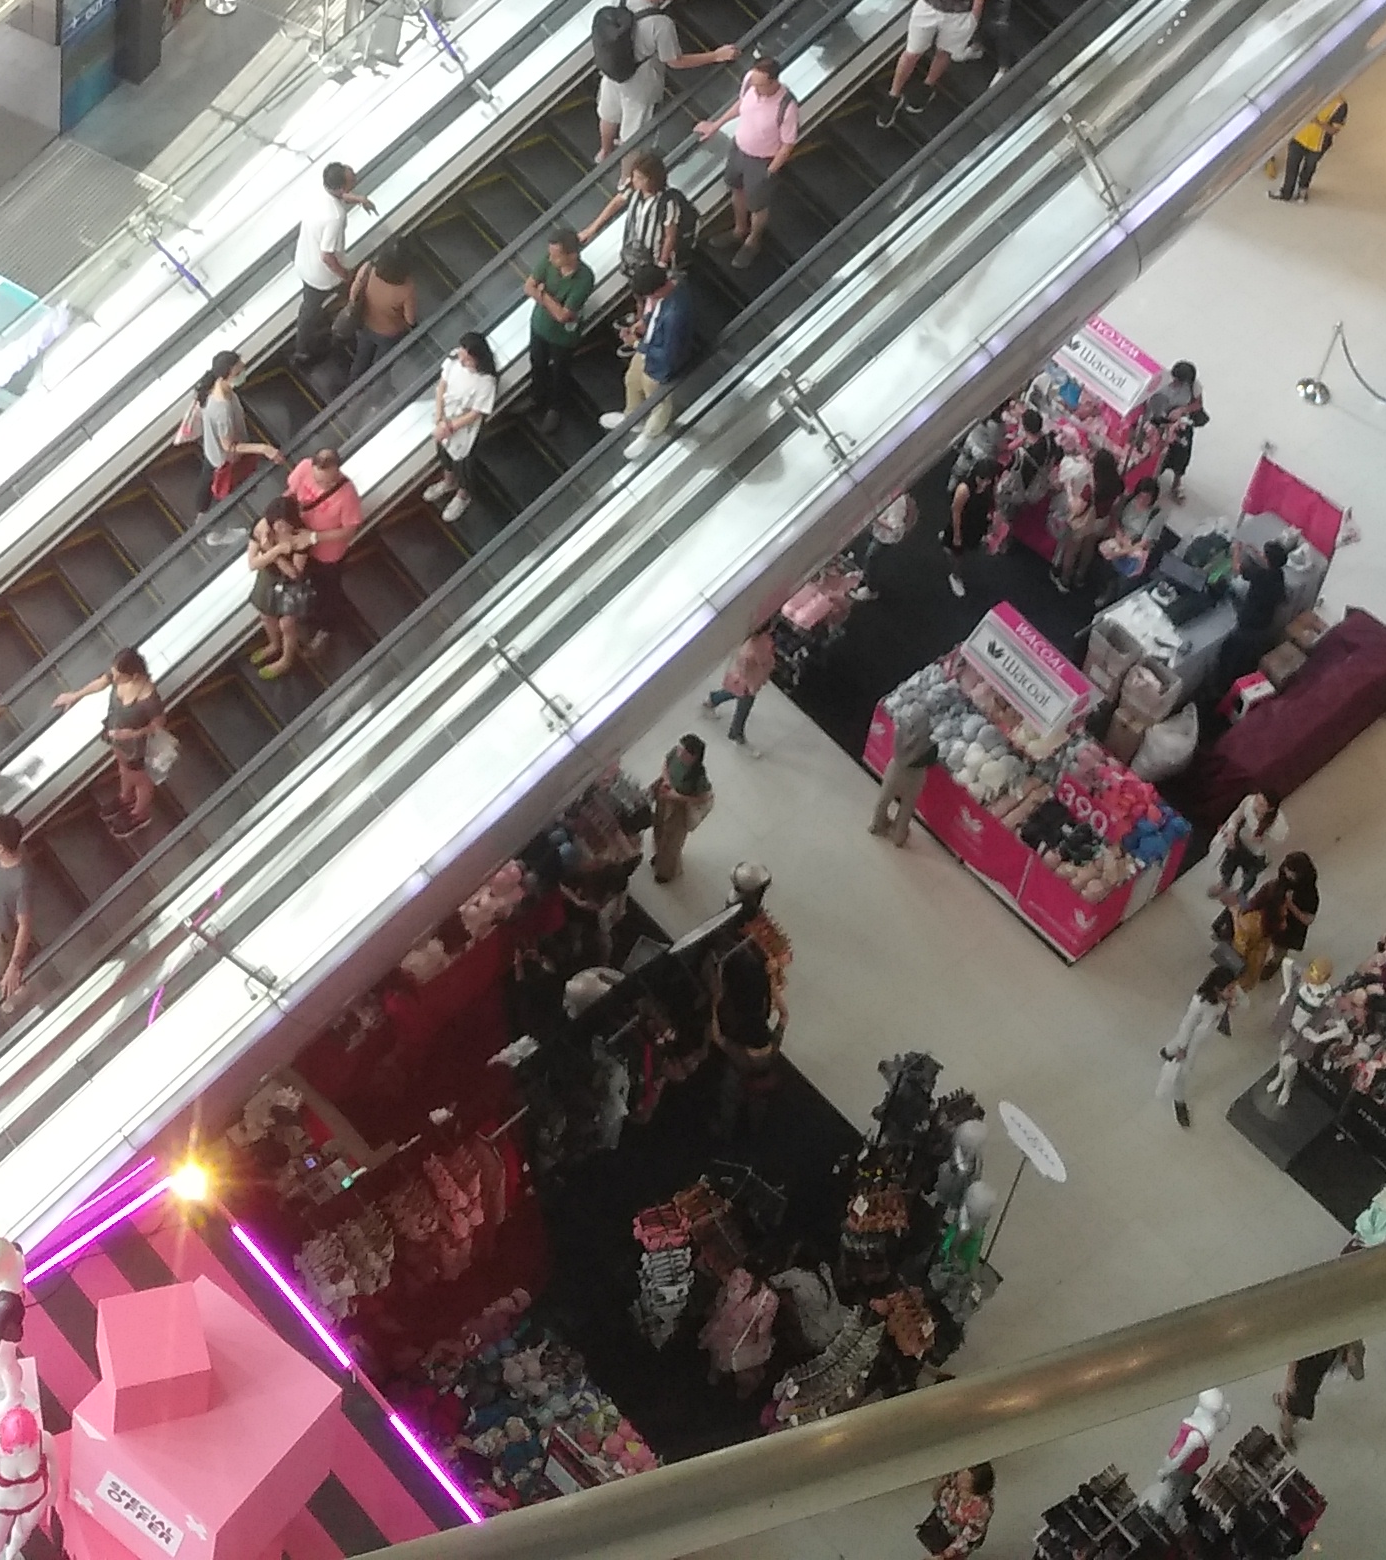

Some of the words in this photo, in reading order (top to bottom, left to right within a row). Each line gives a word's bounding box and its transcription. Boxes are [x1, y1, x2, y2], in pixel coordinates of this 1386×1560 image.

[1015, 622, 1067, 674] WACOAL
[1001, 656, 1051, 708] Wacoal
[107, 1488, 172, 1545] OFFER
[109, 1480, 174, 1540] SPECIAL
